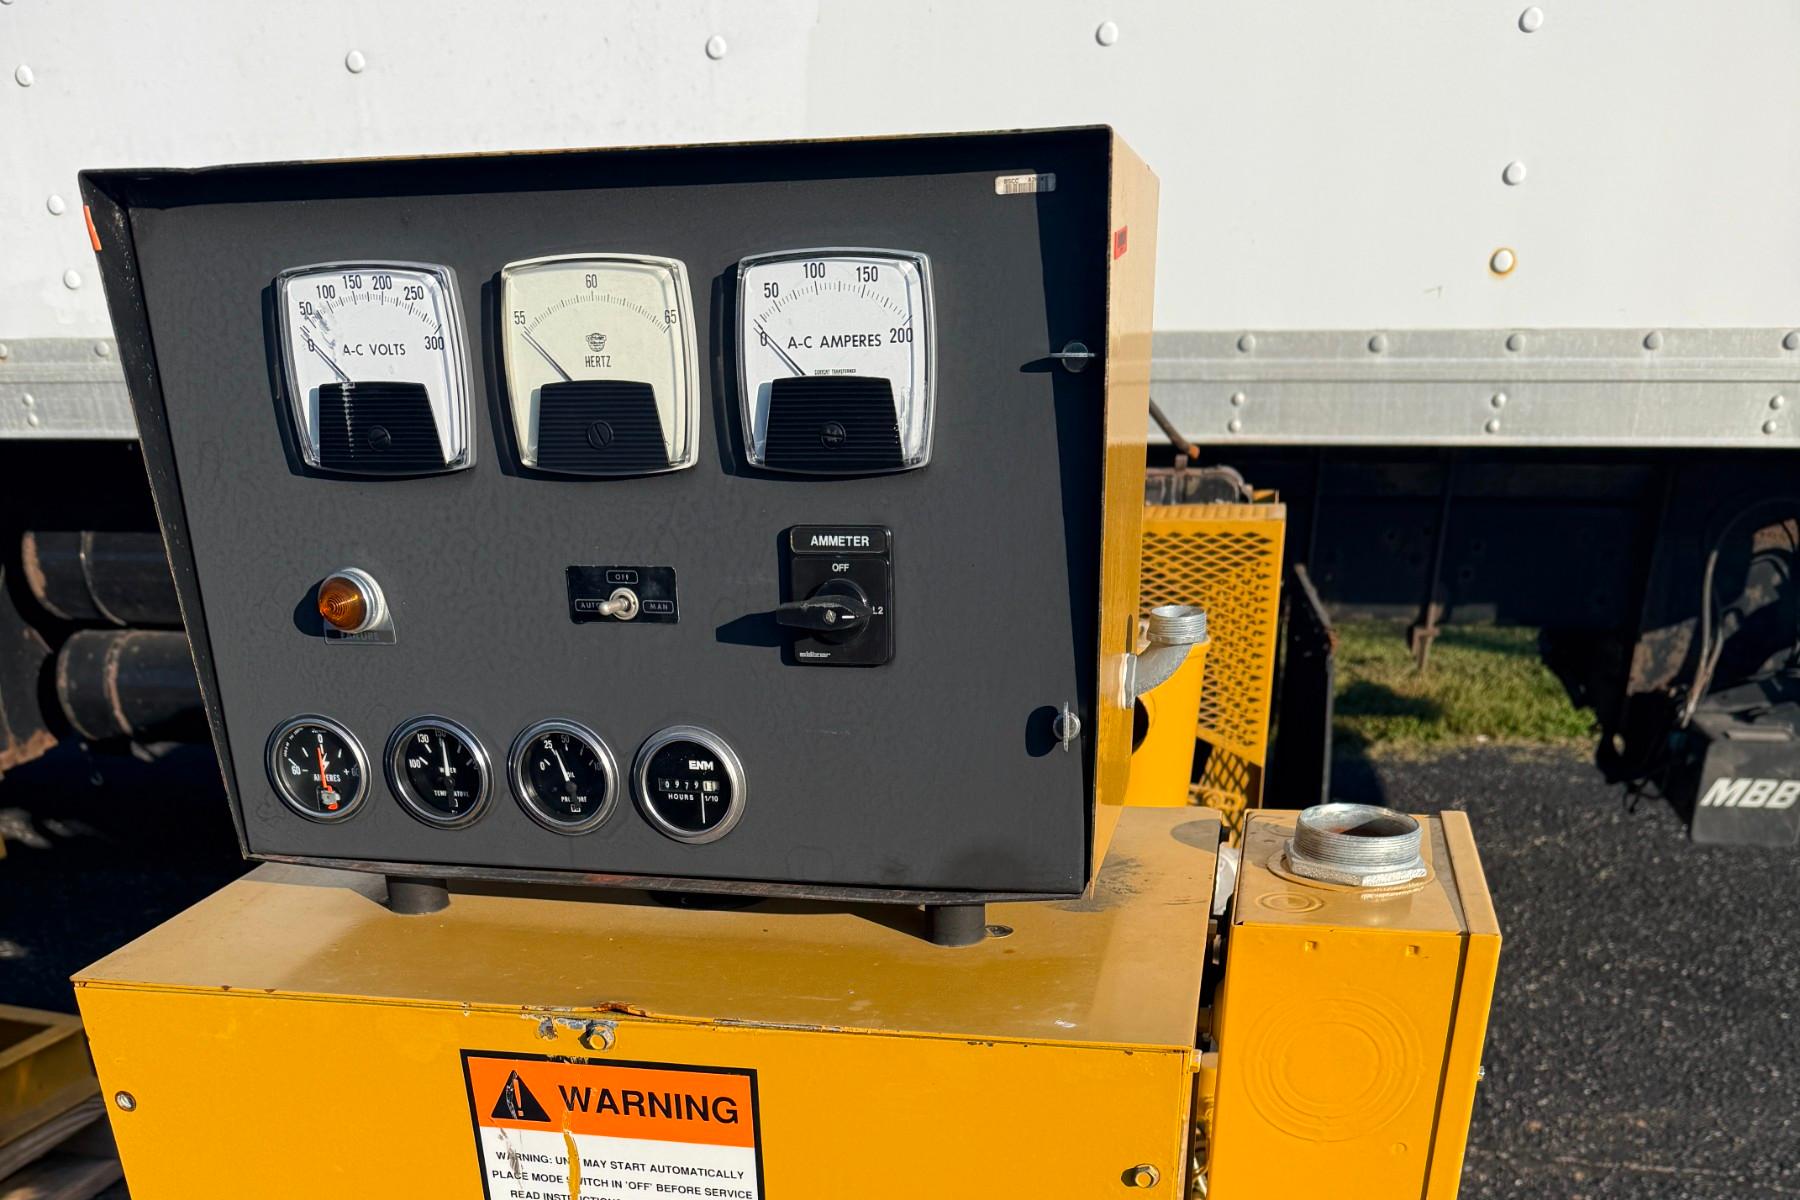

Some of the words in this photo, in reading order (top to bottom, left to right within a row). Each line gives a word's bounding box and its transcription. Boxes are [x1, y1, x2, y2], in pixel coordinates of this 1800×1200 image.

[803, 262, 826, 279] 100
[856, 266, 879, 282] 150
[342, 275, 362, 289] 150
[372, 276, 392, 290] 200
[585, 274, 598, 289] 60
[316, 285, 335, 299] 100
[403, 286, 424, 301] 250
[764, 282, 779, 298] 50
[299, 302, 313, 316] 50
[513, 310, 526, 325] 55
[664, 310, 677, 324] 65
[760, 331, 768, 347] 0
[787, 335, 813, 349] A-C
[819, 334, 882, 349] AMPERES
[889, 327, 913, 343] 200
[308, 339, 315, 352] 0
[343, 344, 364, 356] A-C
[369, 343, 406, 356] VOLTS
[424, 336, 445, 350] 300
[585, 355, 612, 368] HERTZ
[810, 535, 870, 547] AMMETER
[832, 563, 850, 572] OFF
[650, 602, 668, 610] MAN
[317, 733, 324, 744] 0
[417, 733, 430, 744] 130
[543, 740, 553, 749] 25
[408, 758, 421, 769] 100
[688, 760, 714, 771] ENM
[668, 793, 695, 801] HOURS
[1700, 777, 1800, 809] MBB
[558, 1084, 740, 1125] WARNING
[583, 1158, 607, 1170] MAY
[610, 1160, 646, 1172] START
[650, 1164, 744, 1180] AUTOMATICALLY
[492, 1170, 529, 1181] PLACE
[531, 1172, 564, 1184] MODE
[611, 1180, 623, 1189] IN
[656, 1183, 702, 1196] BEFORE
[704, 1187, 753, 1200] SERVICE
[510, 1189, 540, 1200] READ
